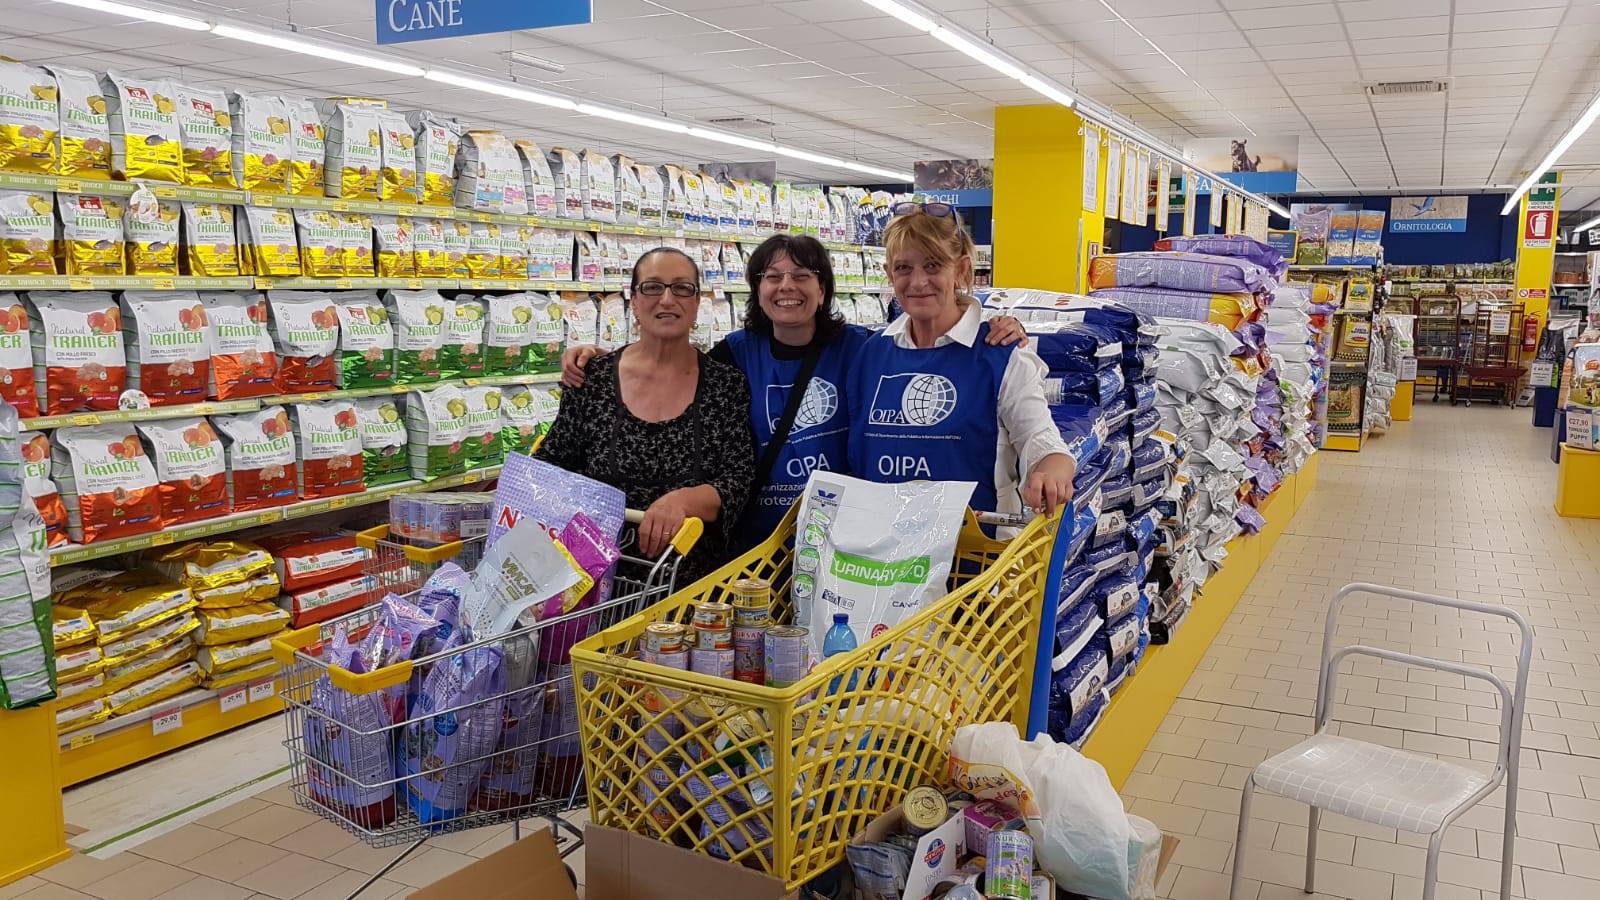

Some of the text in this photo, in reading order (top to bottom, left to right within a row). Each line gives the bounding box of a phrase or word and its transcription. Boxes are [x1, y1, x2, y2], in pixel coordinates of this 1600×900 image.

[388, 0, 463, 32] CANE
[76, 217, 121, 228] TRAINER
[51, 322, 86, 335] Natural
[53, 334, 118, 348] TRAINER
[149, 332, 204, 346] TRAINER
[288, 331, 334, 343] TRAINER
[872, 409, 905, 423] OIPA
[311, 429, 358, 444] TRAINER
[164, 446, 216, 464] TRAINER
[84, 461, 140, 476] TRAINER
[878, 455, 931, 477] OIPA
[834, 560, 898, 582] URINARY
